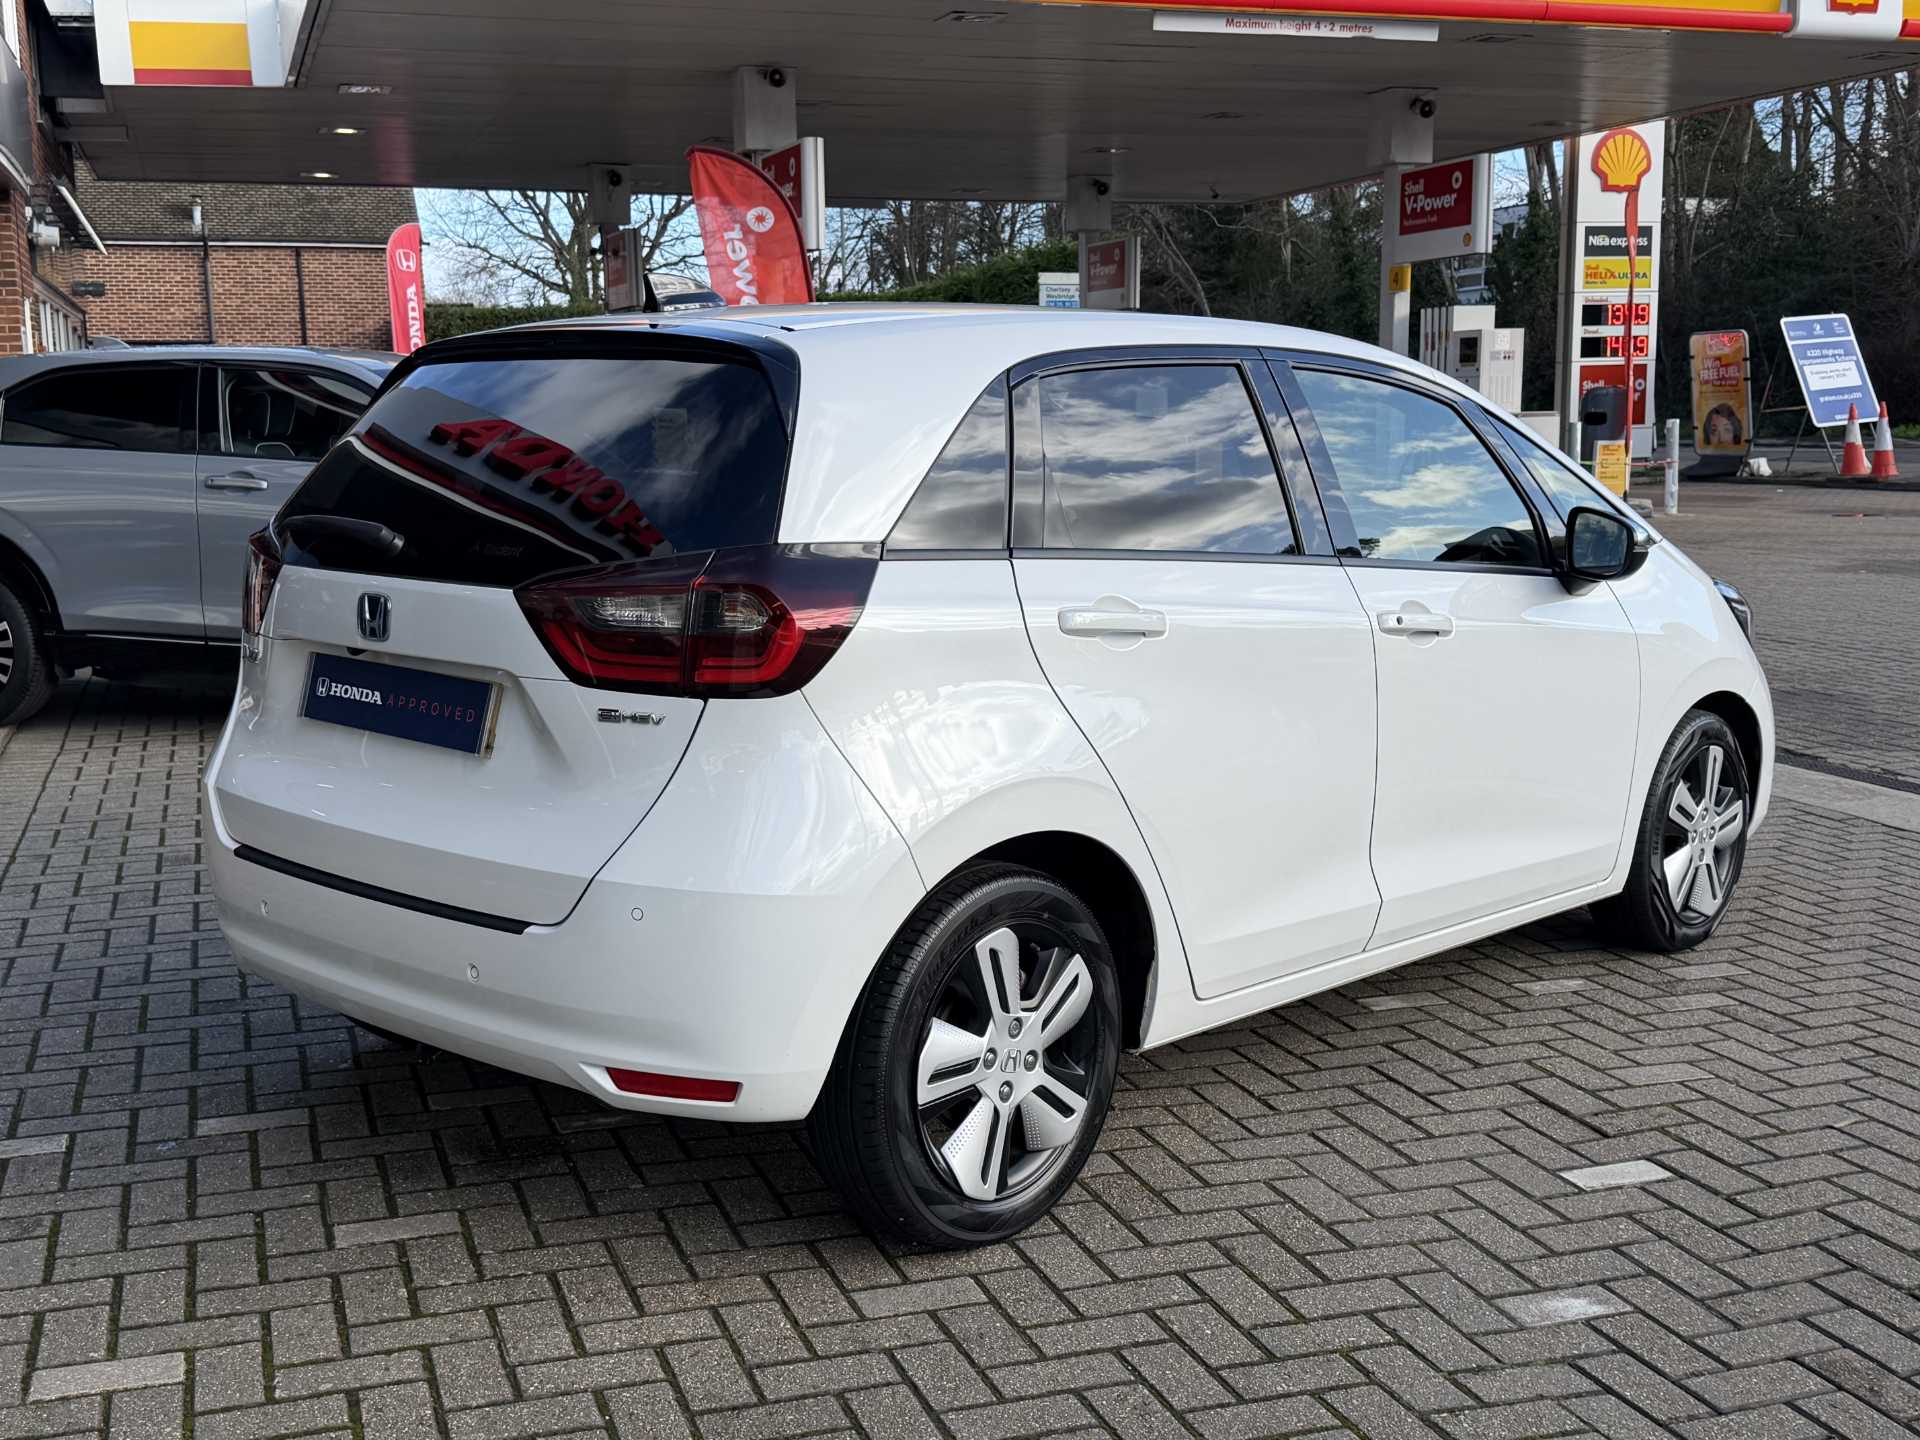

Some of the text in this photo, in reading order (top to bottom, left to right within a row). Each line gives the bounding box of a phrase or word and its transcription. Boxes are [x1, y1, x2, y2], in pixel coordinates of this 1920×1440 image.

[1225, 17, 1275, 30] Maximum
[1279, 19, 1312, 32] height
[1339, 22, 1374, 33] metres
[1404, 178, 1425, 195] Shell
[1404, 192, 1457, 215] V-Power
[1588, 235, 1610, 246] Nisa
[1392, 271, 1399, 290] 4
[1703, 358, 1720, 369] Win
[1700, 367, 1740, 380] FREE FUEL
[328, 681, 476, 723] HONDA APPROVED
